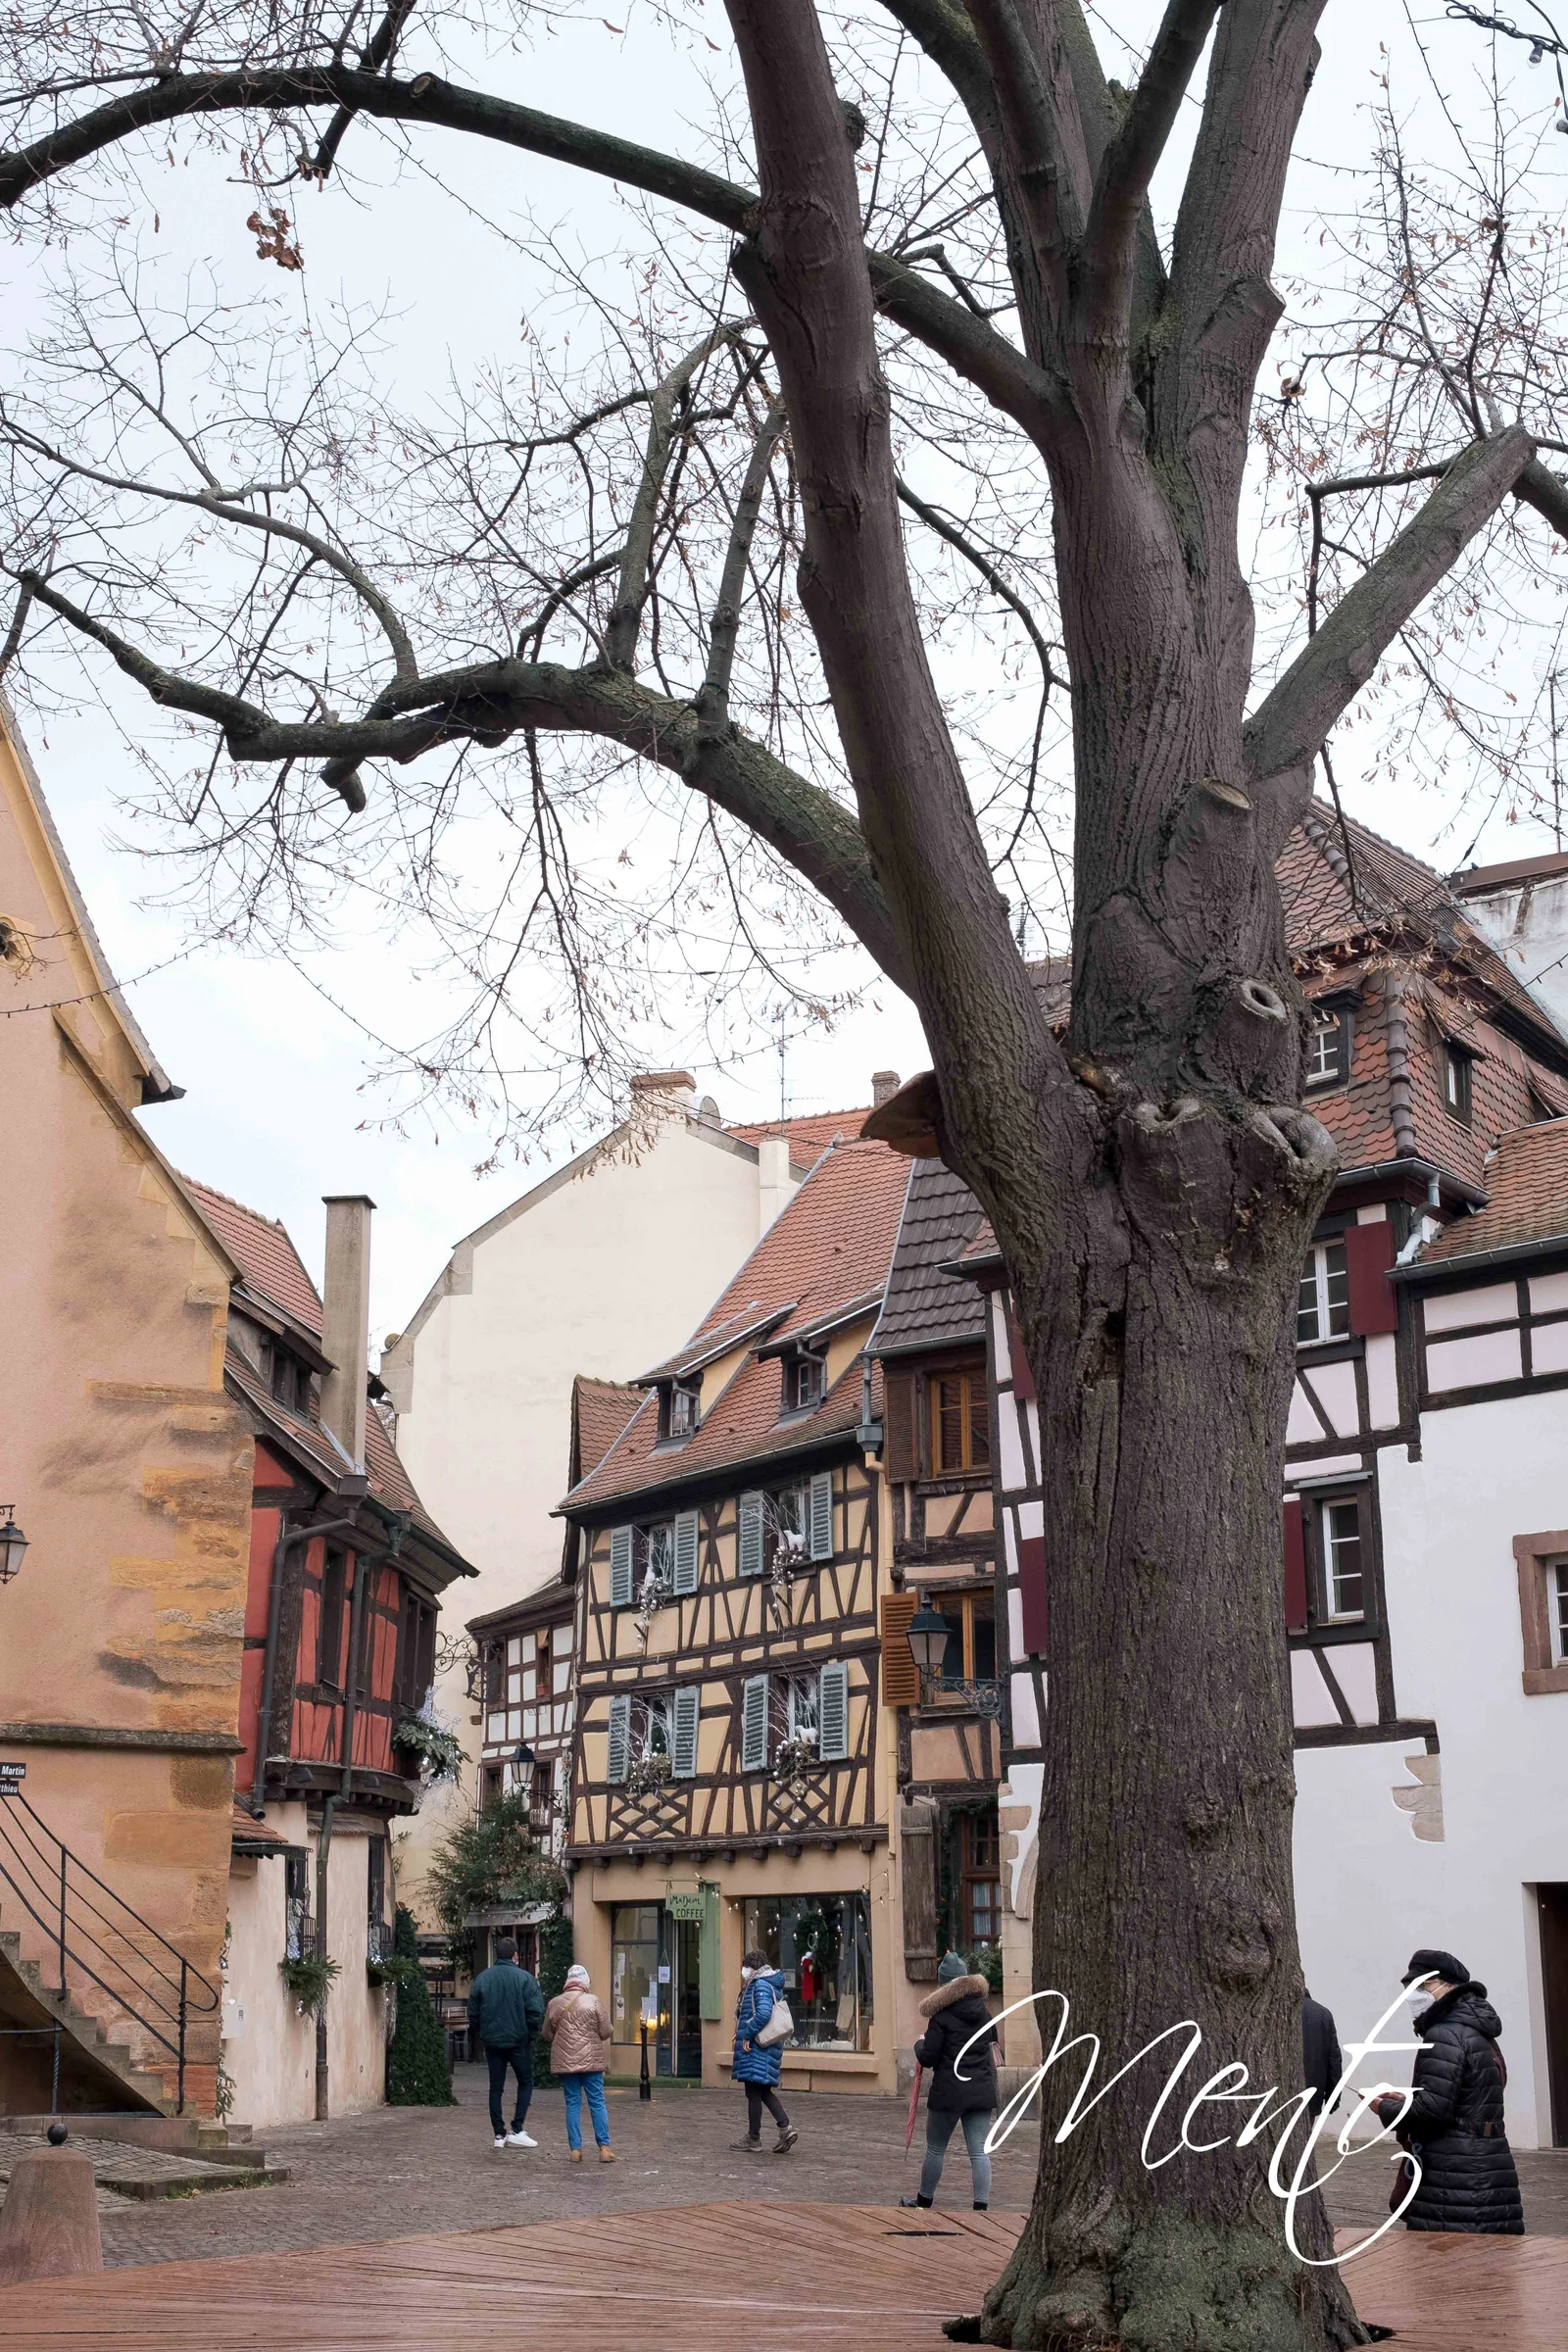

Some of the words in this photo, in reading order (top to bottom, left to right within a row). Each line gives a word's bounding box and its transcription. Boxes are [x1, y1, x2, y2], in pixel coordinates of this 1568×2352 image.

[1, 1765, 25, 1775] Martin
[0, 1784, 18, 1792] thieu
[676, 1908, 704, 1918] COFFEE
